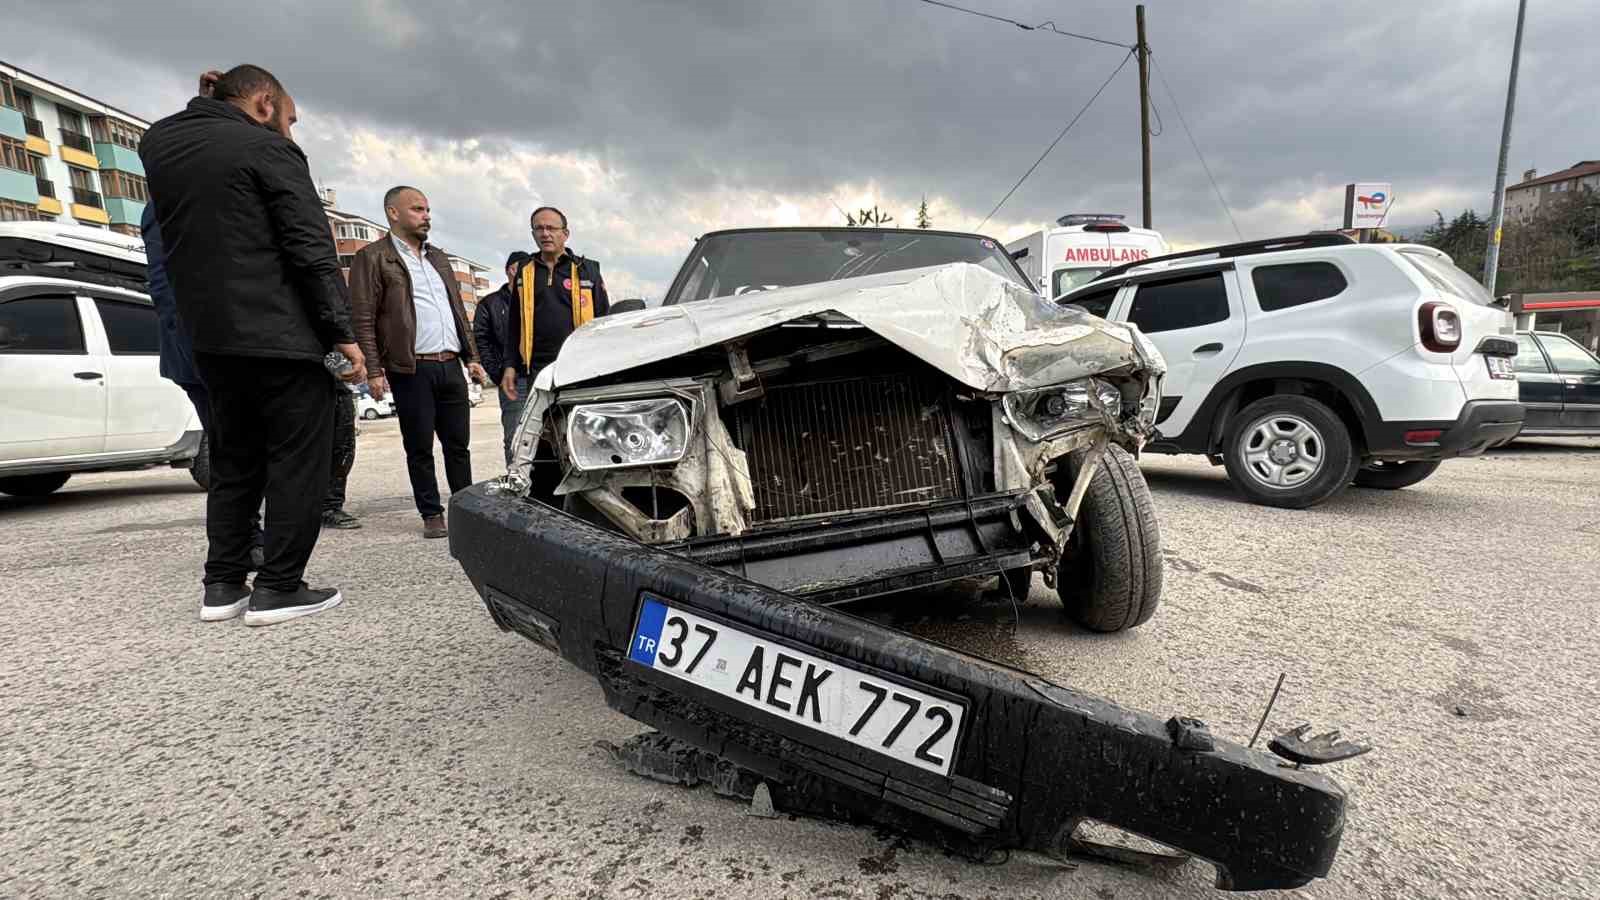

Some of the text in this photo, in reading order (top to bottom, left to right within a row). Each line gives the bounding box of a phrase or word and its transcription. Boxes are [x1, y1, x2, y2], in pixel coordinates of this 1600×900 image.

[1065, 247, 1149, 262] AMBULANS
[639, 635, 656, 654] TR
[658, 616, 953, 766] 37 AEK 772
